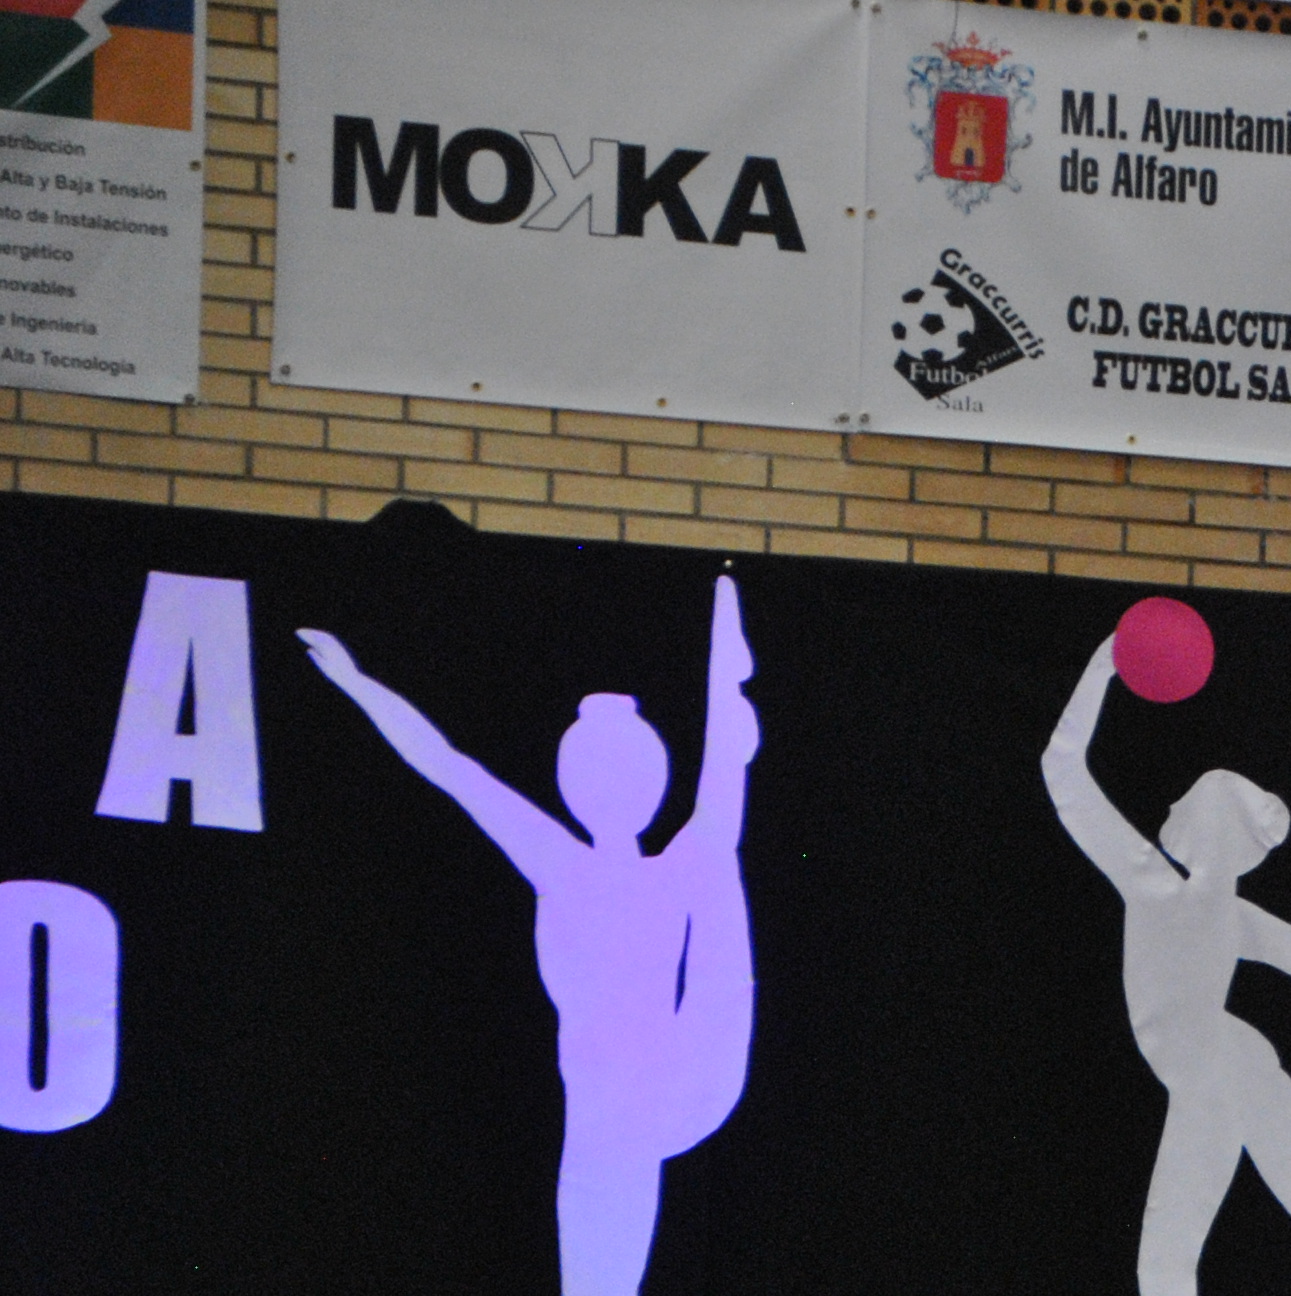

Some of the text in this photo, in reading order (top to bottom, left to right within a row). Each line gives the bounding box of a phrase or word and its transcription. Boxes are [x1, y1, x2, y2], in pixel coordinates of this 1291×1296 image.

[1060, 90, 1127, 140] M.I.
[0, 169, 167, 201] Alta y Baja Tensión
[1060, 149, 1219, 206] de Alfaro
[26, 210, 48, 223] de
[53, 210, 169, 237] Instalaciones
[939, 247, 1046, 360] Graccurris
[1066, 296, 1128, 336] C.D.
[2, 347, 35, 365] Alta
[1092, 350, 1240, 400] FUTBOL
[94, 570, 264, 832] A
